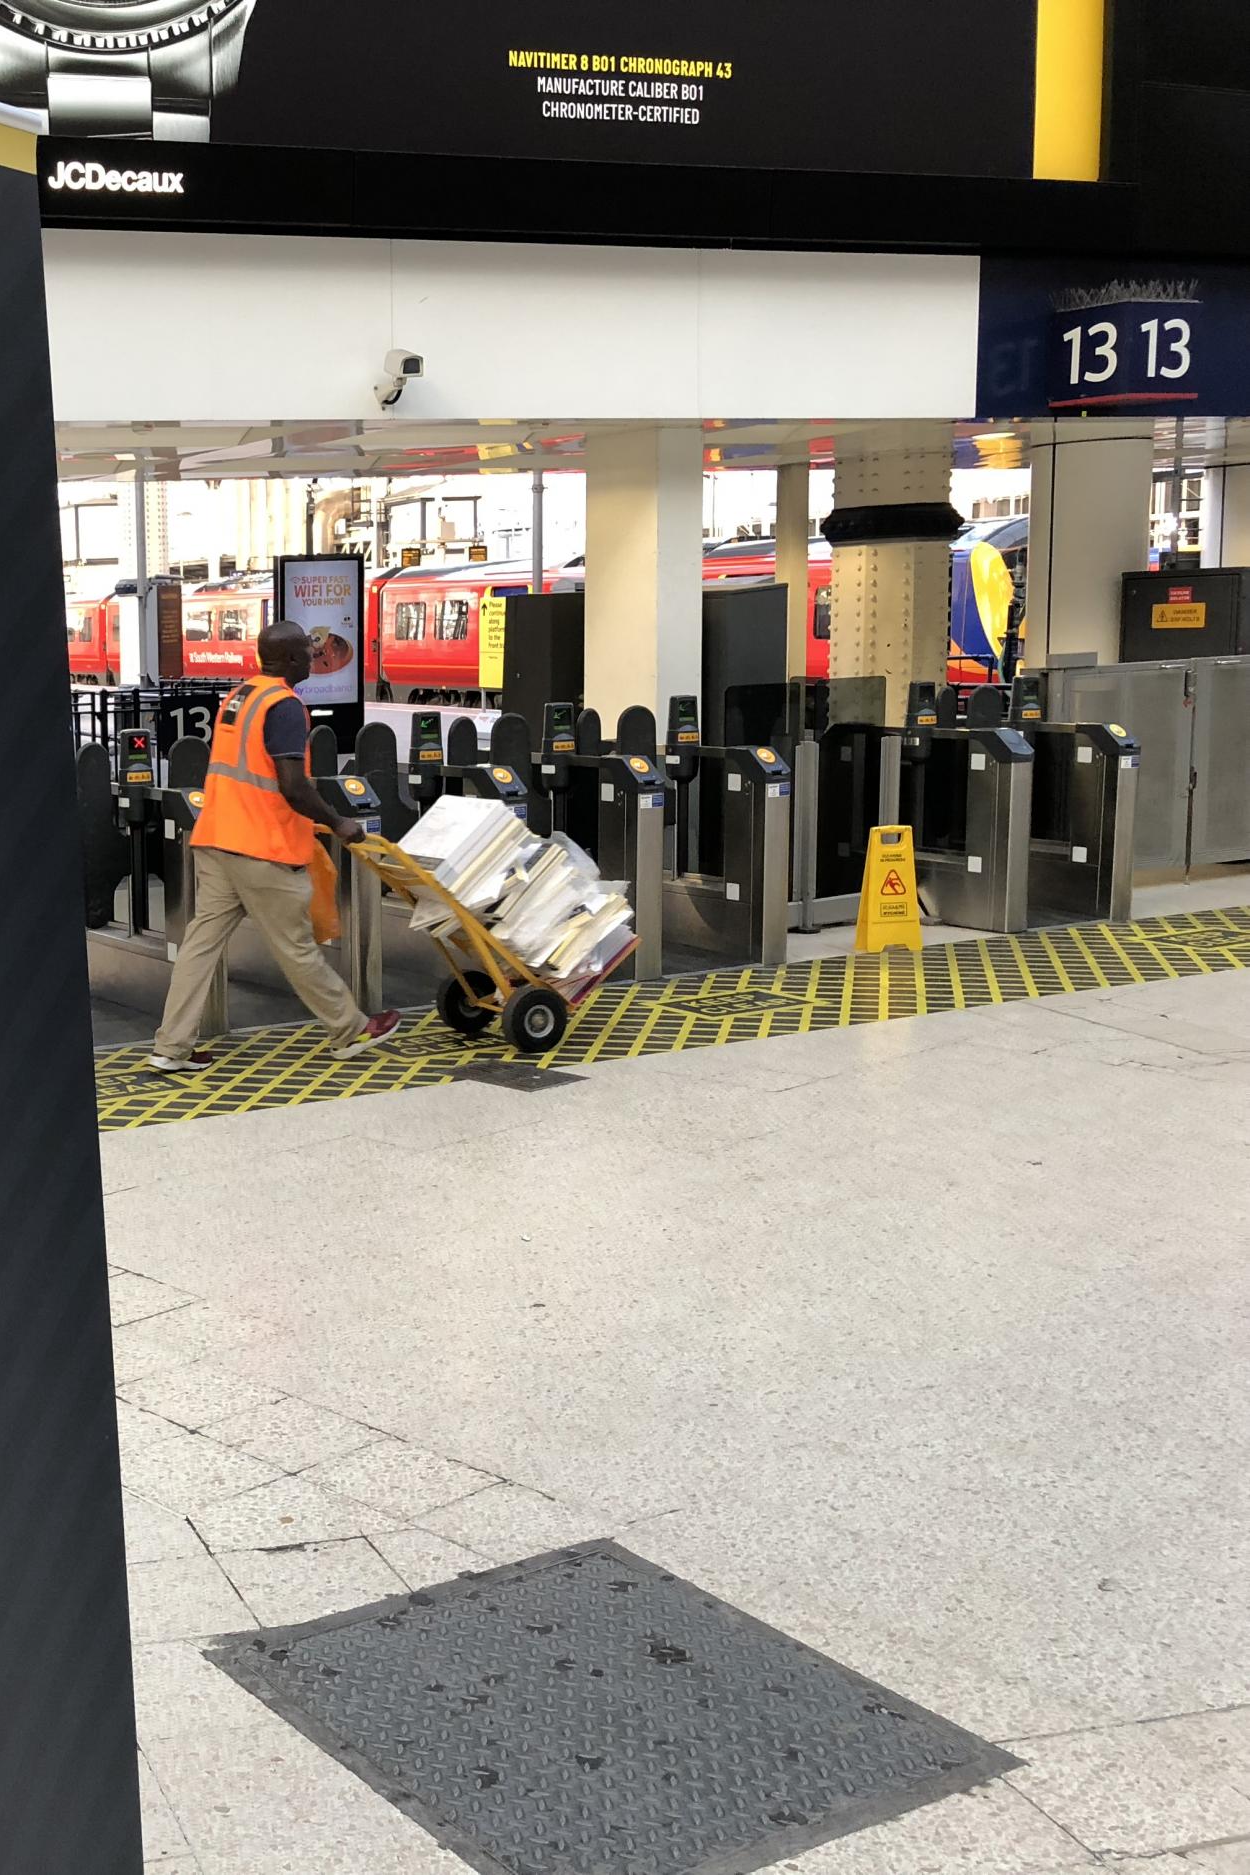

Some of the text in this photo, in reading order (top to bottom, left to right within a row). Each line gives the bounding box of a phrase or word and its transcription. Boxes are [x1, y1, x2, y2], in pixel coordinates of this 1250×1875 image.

[508, 50, 577, 70] NAVITIMER
[580, 55, 589, 71] 8
[619, 57, 713, 78] CHRONOGRAPH
[716, 62, 733, 79] 43
[537, 76, 626, 97] MANUFACTURE
[628, 81, 678, 100] CALIBER
[542, 101, 700, 124] CHRONOMETER-CERTIFIED
[48, 161, 184, 193] JCDecaux
[1063, 318, 1191, 385] 13 13
[294, 584, 352, 598] WIFI FOR
[170, 706, 212, 747] 13
